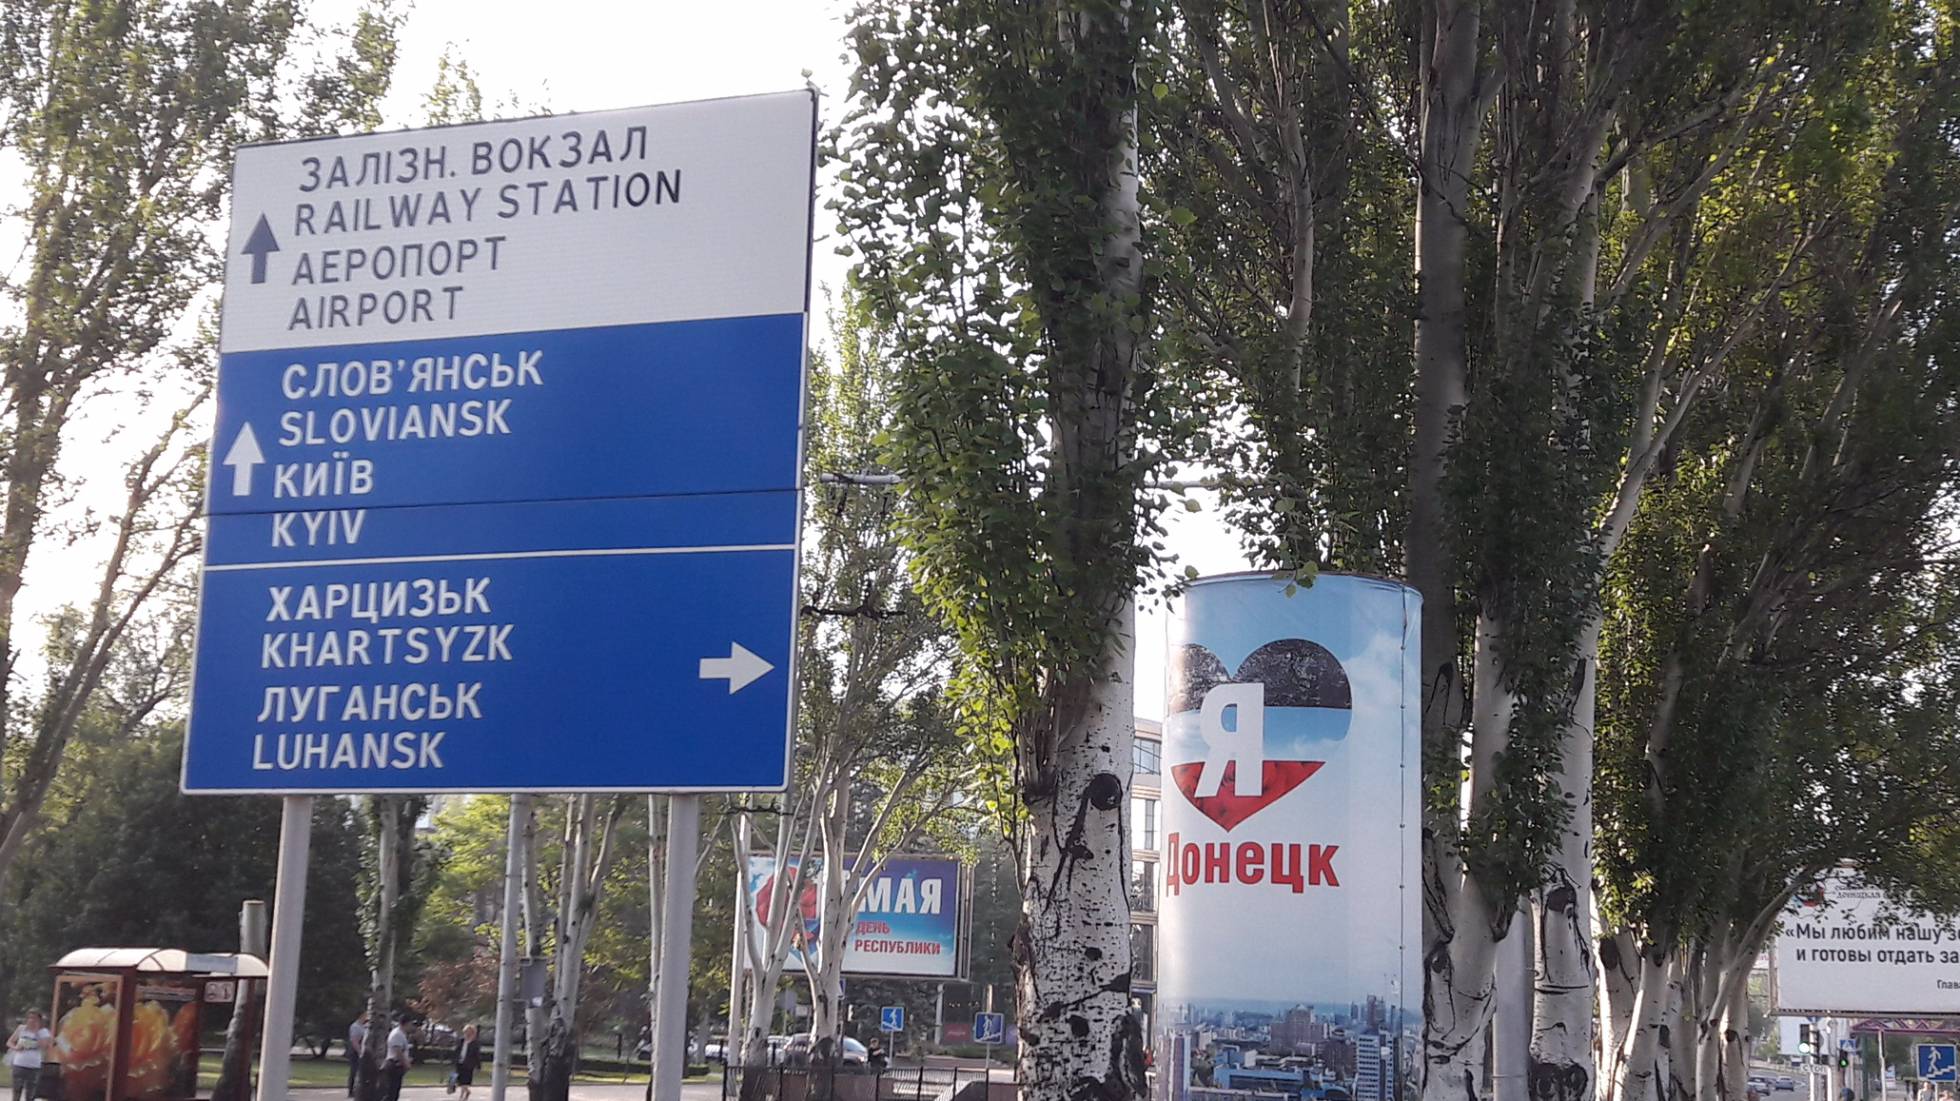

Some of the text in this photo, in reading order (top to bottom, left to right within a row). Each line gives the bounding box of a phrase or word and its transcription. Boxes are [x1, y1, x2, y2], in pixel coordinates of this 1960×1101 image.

[299, 125, 647, 193] ЗАЛІЗН. ВОКЗАЛ
[295, 169, 681, 237] RAILWAY STATION
[291, 235, 507, 286] АЕРОПОРТ
[288, 285, 464, 331] AIRPORT
[282, 350, 543, 400] СЛОВ'ЯНСЬК
[279, 398, 512, 447] SLOVIANSK
[274, 451, 373, 498] КИЇВ
[271, 509, 366, 547] KYIV
[266, 577, 491, 624] ХАРЦИЗЬК
[261, 624, 514, 669] KHARTSYZK
[257, 682, 481, 723] ЛУГАНСЬК
[253, 731, 445, 771] LUHANSK
[1194, 682, 1264, 798] Я
[1167, 832, 1340, 897] Донецк
[858, 877, 942, 914] МАЯ
[854, 939, 941, 955] РЕСПУБЛИКИ
[856, 921, 891, 935] ДЕНЬ
[1785, 923, 1960, 945] «Мы любим нашу з
[1796, 948, 1959, 965] и готовы отдать за
